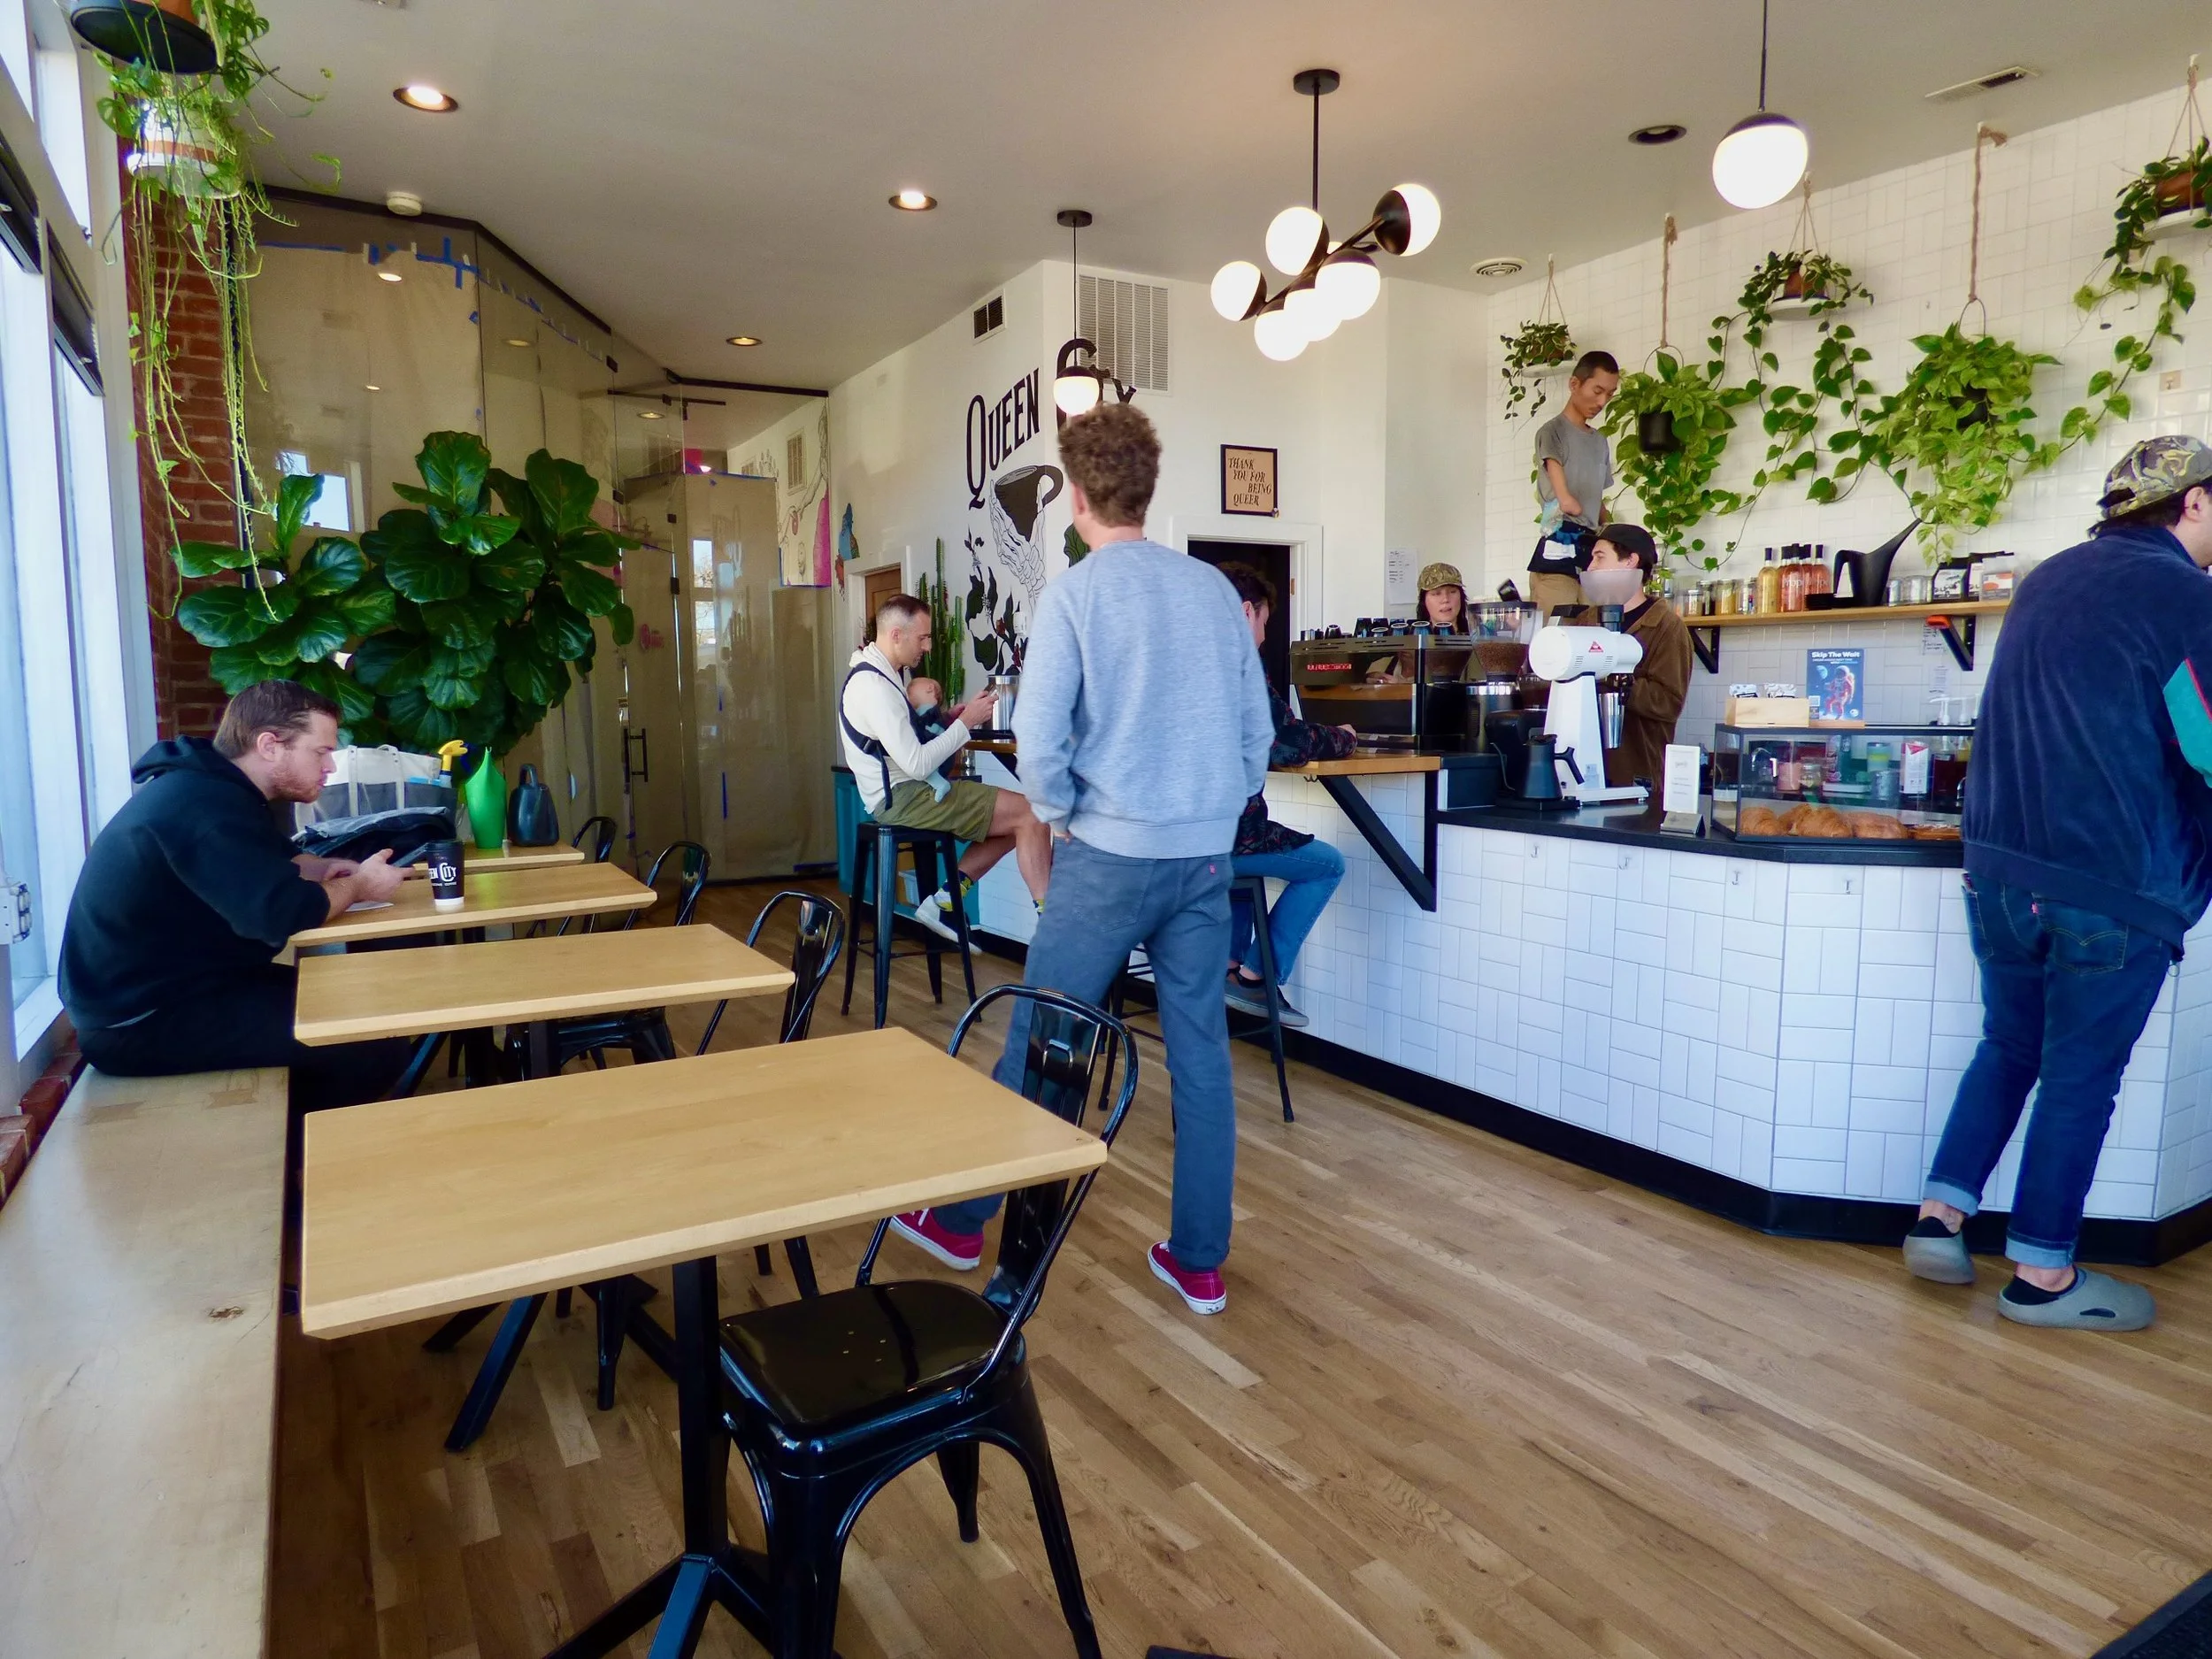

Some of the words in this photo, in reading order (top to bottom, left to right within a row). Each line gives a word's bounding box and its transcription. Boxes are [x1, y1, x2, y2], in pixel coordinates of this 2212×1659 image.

[966, 367, 1040, 511] QUEEN
[1228, 457, 1255, 470] THANK
[1233, 470, 1247, 481] YOU
[1249, 471, 1266, 483] FOR
[1248, 483, 1272, 495] BEING
[1233, 493, 1260, 506] QUEER
[440, 863, 457, 881] CITY
